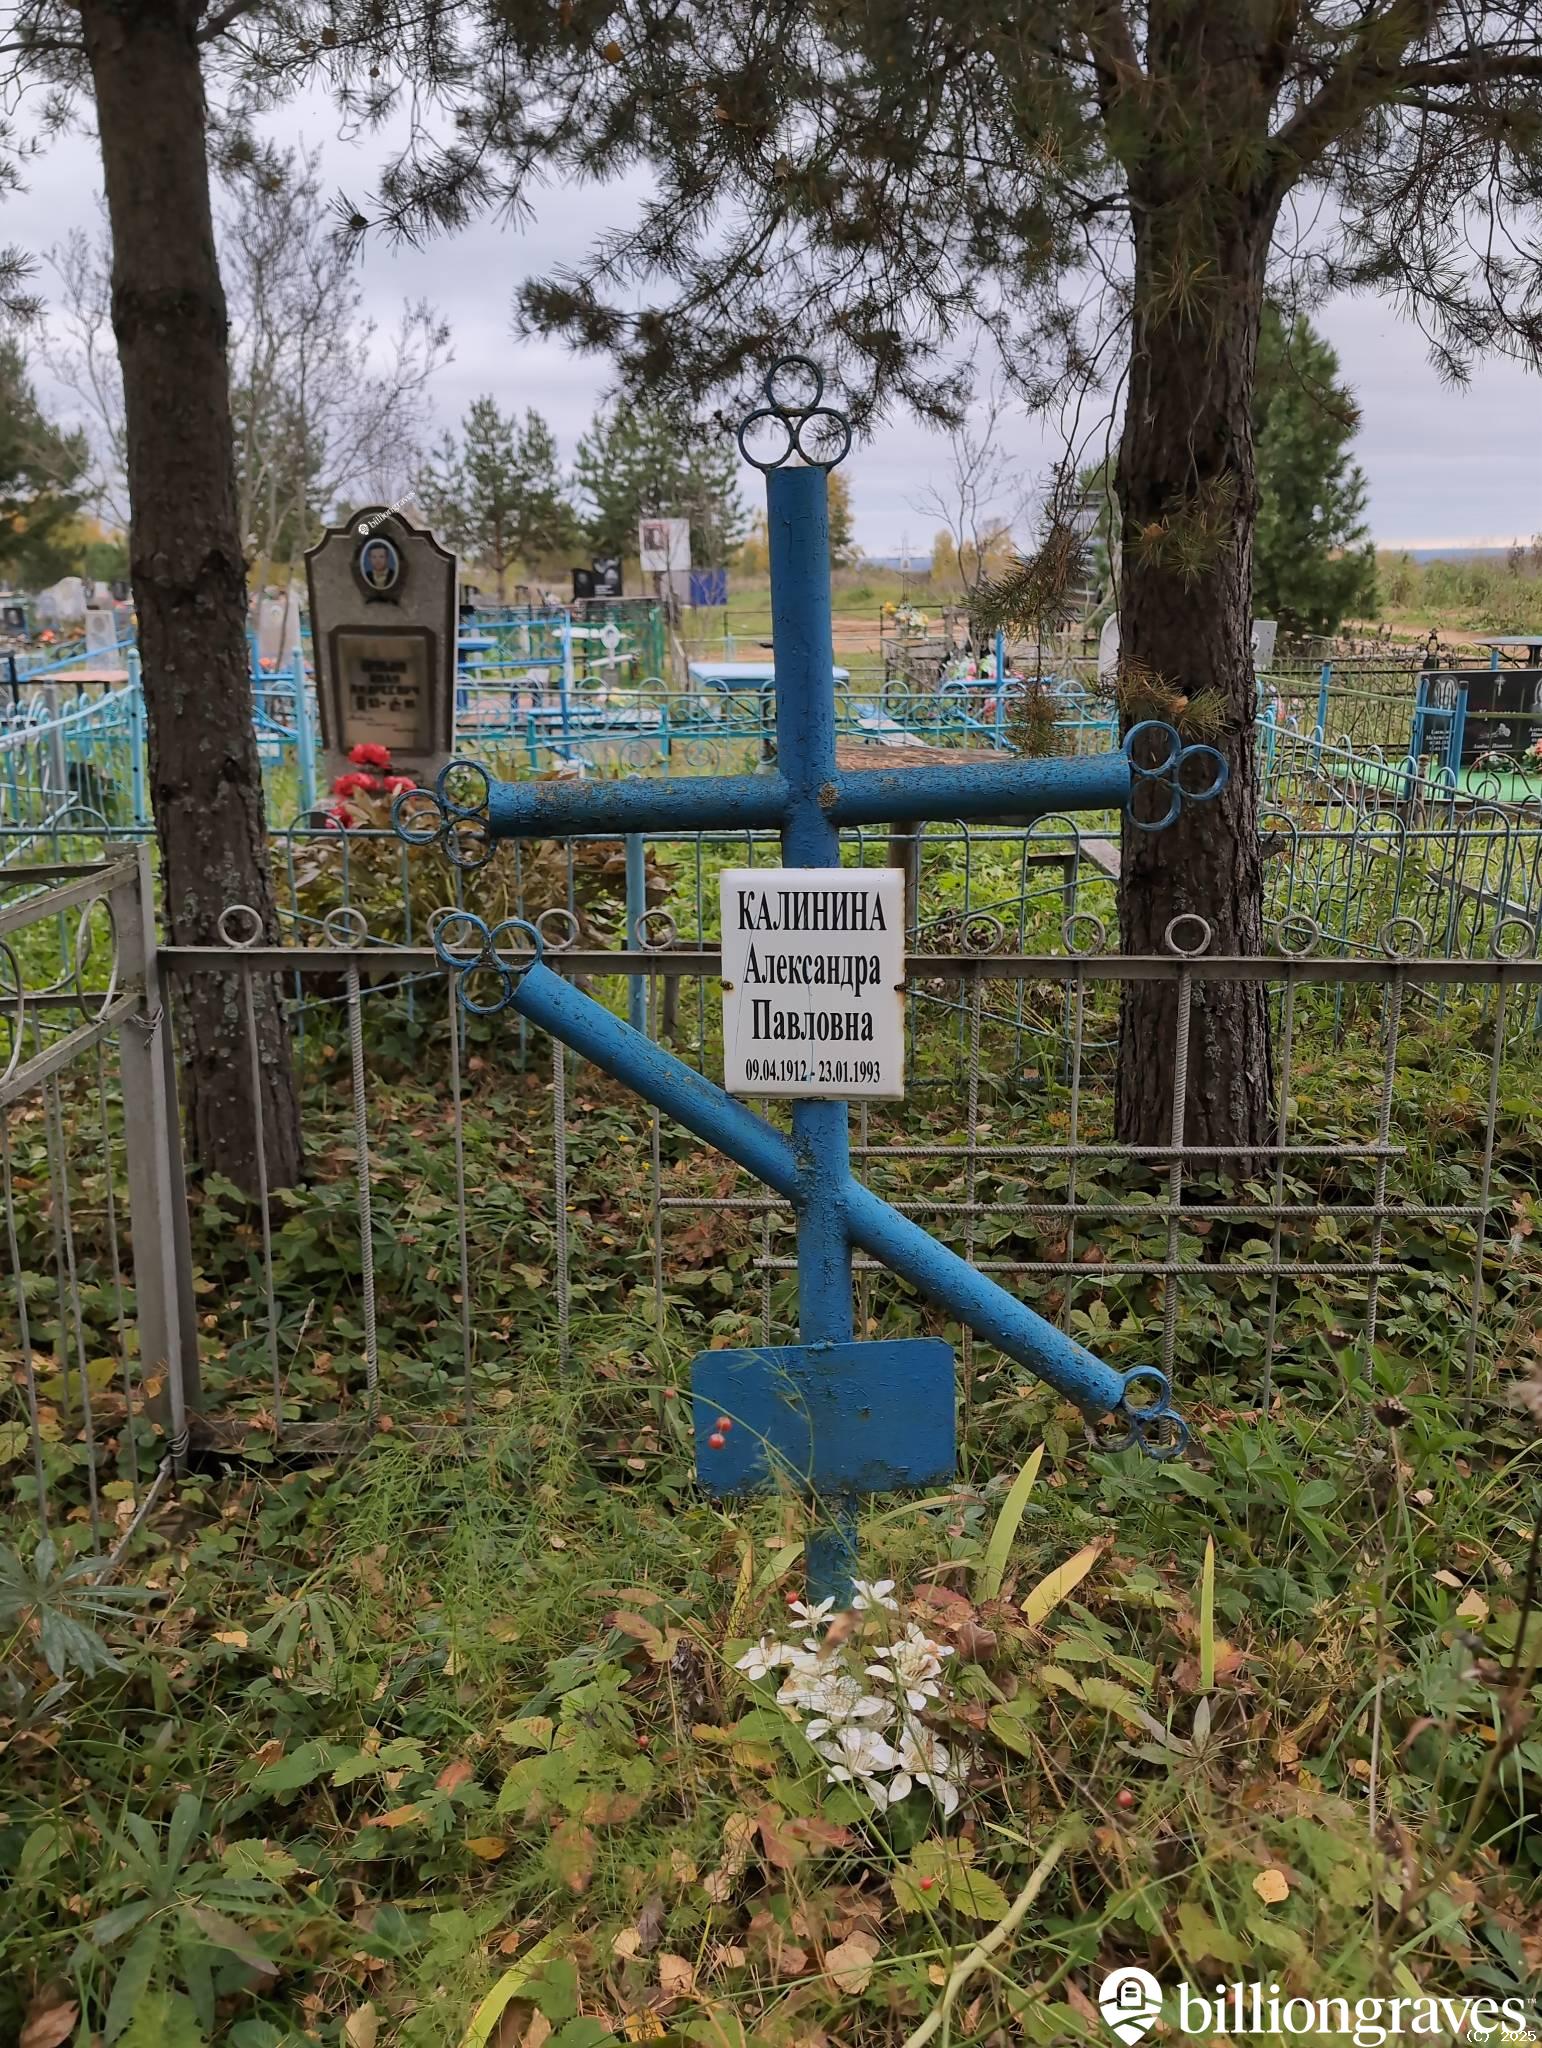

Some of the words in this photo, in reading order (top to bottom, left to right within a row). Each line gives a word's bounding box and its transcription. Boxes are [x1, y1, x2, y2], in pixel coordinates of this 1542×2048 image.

[737, 890, 887, 931] КАЛИНИНА
[743, 942, 881, 997] Александра
[751, 999, 874, 1041] Павловна
[745, 1058, 807, 1082] 09.04.1912
[818, 1060, 881, 1083] 23.01.1993
